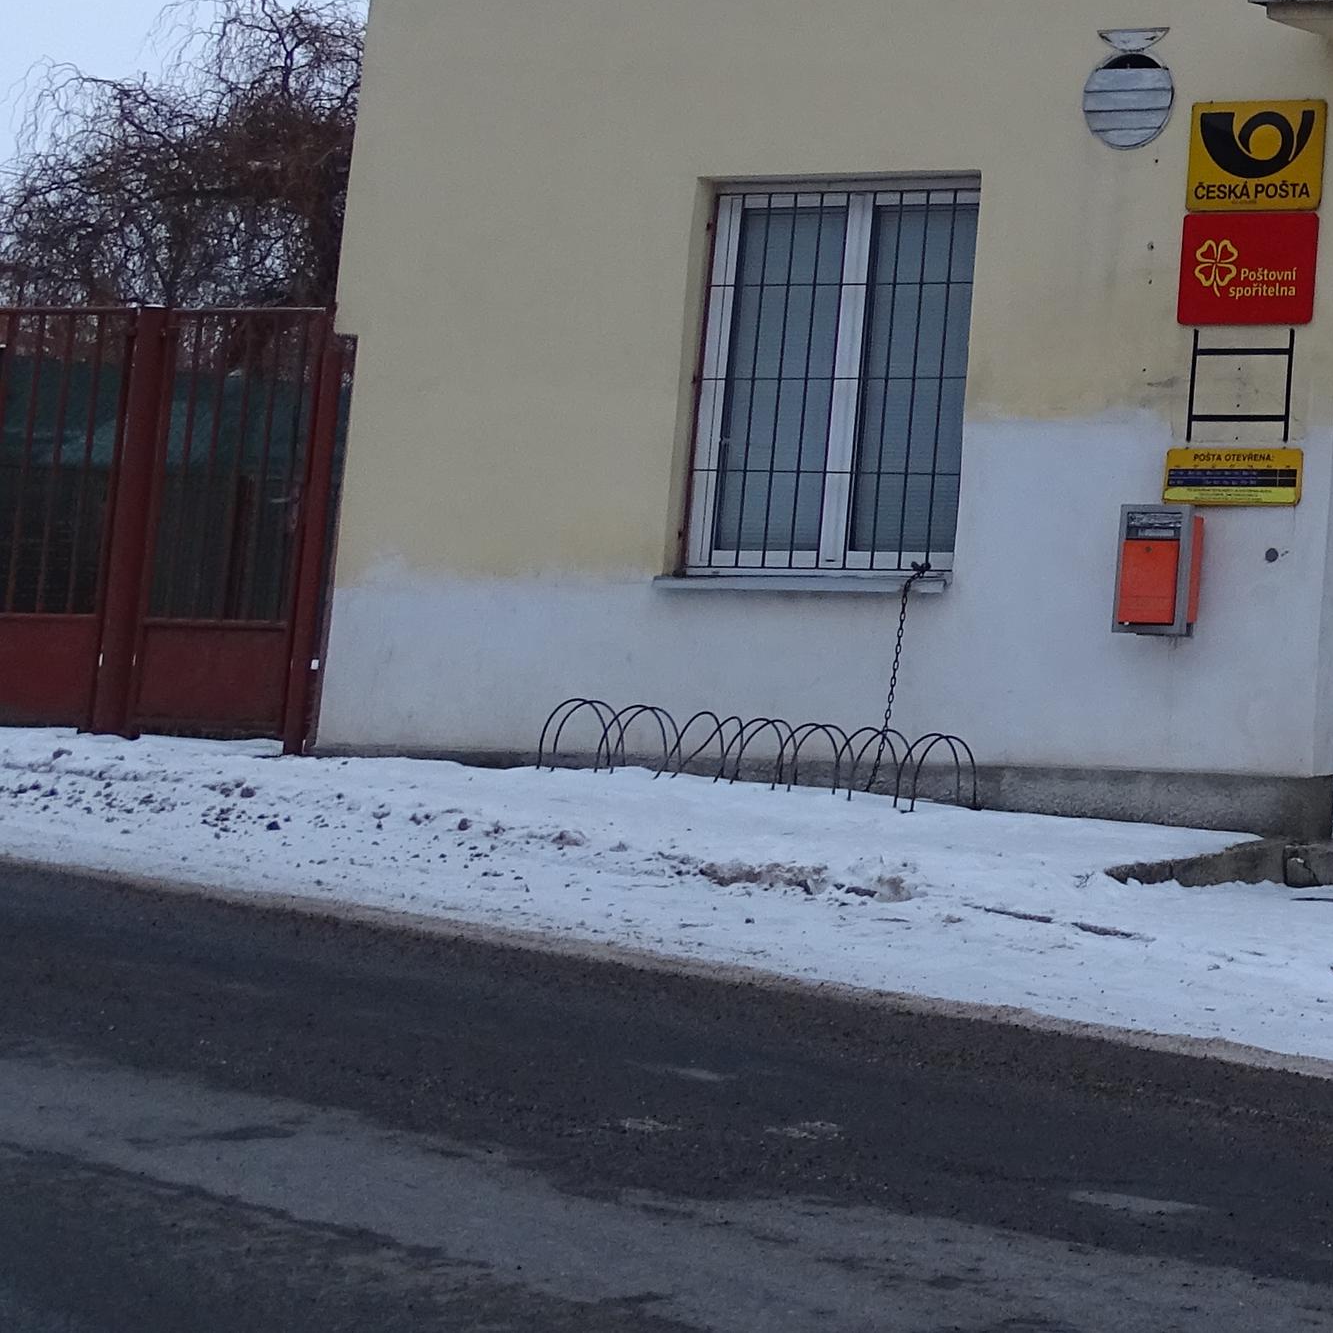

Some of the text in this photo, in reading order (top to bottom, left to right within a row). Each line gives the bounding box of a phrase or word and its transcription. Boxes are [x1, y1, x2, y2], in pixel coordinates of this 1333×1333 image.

[1194, 180, 1310, 200] ČESKÁ POŠTA
[1241, 267, 1296, 281] Poštovní
[1228, 283, 1296, 300] spořitelna
[1193, 452, 1222, 462] POŠTA
